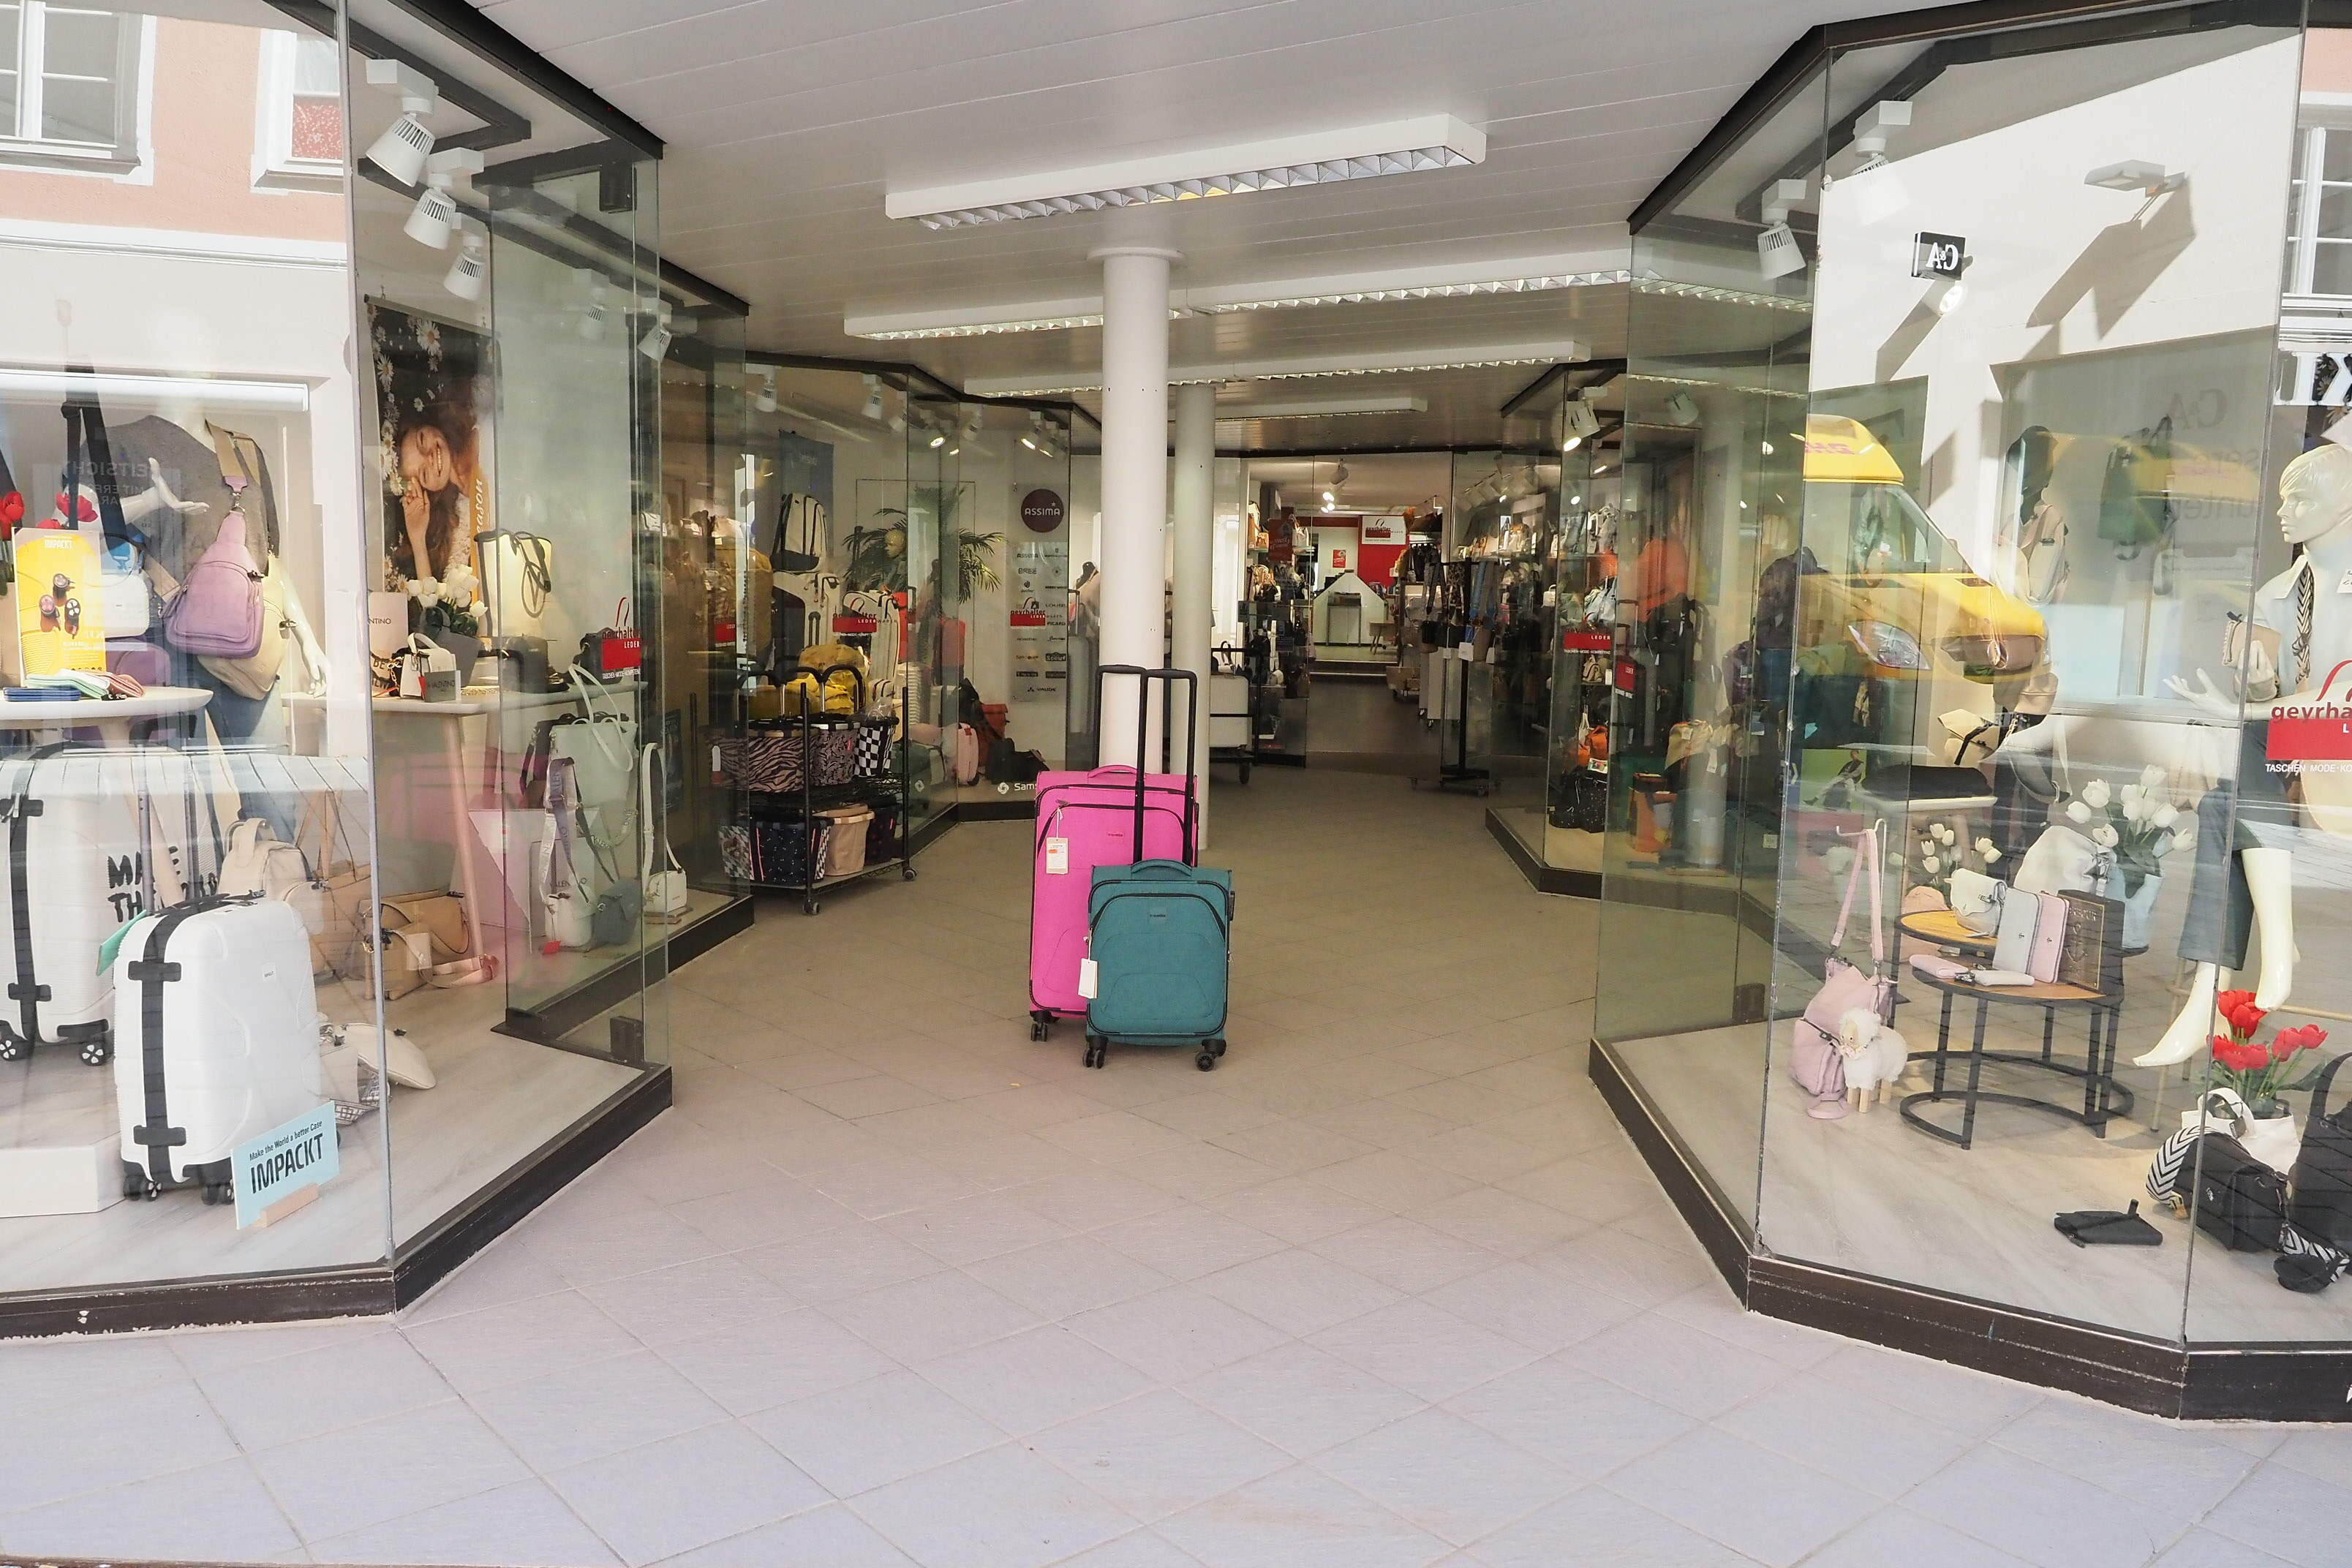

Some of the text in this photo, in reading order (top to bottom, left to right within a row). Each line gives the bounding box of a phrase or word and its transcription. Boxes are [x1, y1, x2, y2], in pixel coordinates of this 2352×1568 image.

[475, 478, 484, 533] eason
[1025, 508, 1060, 516] ASSIMA
[624, 641, 640, 649] LEDER
[2265, 764, 2305, 772] TASCHEN
[249, 1149, 264, 1161] Make
[265, 1145, 274, 1153] the
[274, 1135, 290, 1149] World
[294, 1126, 309, 1139] better
[310, 1120, 323, 1131] Case
[250, 1132, 323, 1194] IMPACKT
